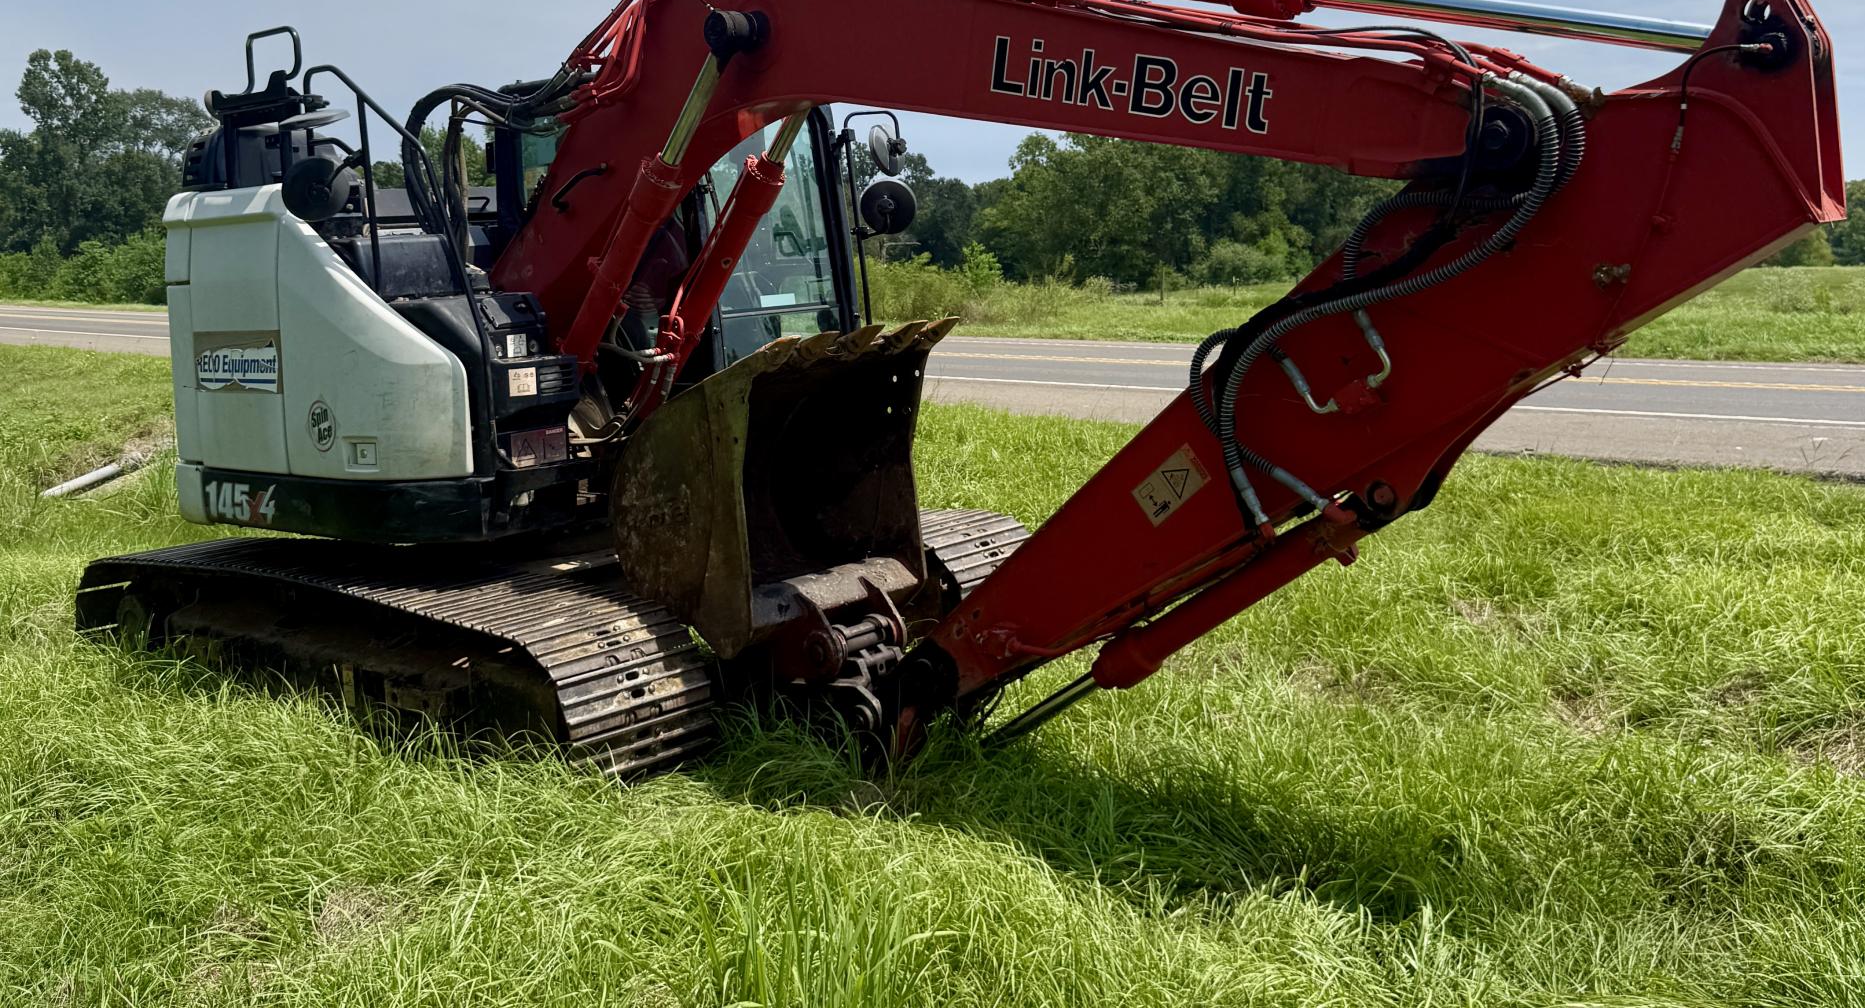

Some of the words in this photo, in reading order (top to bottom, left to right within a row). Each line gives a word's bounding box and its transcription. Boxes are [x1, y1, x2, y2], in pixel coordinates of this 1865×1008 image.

[991, 36, 1272, 134] Link-Belt
[311, 407, 329, 428] Spin
[318, 426, 333, 443] Ace
